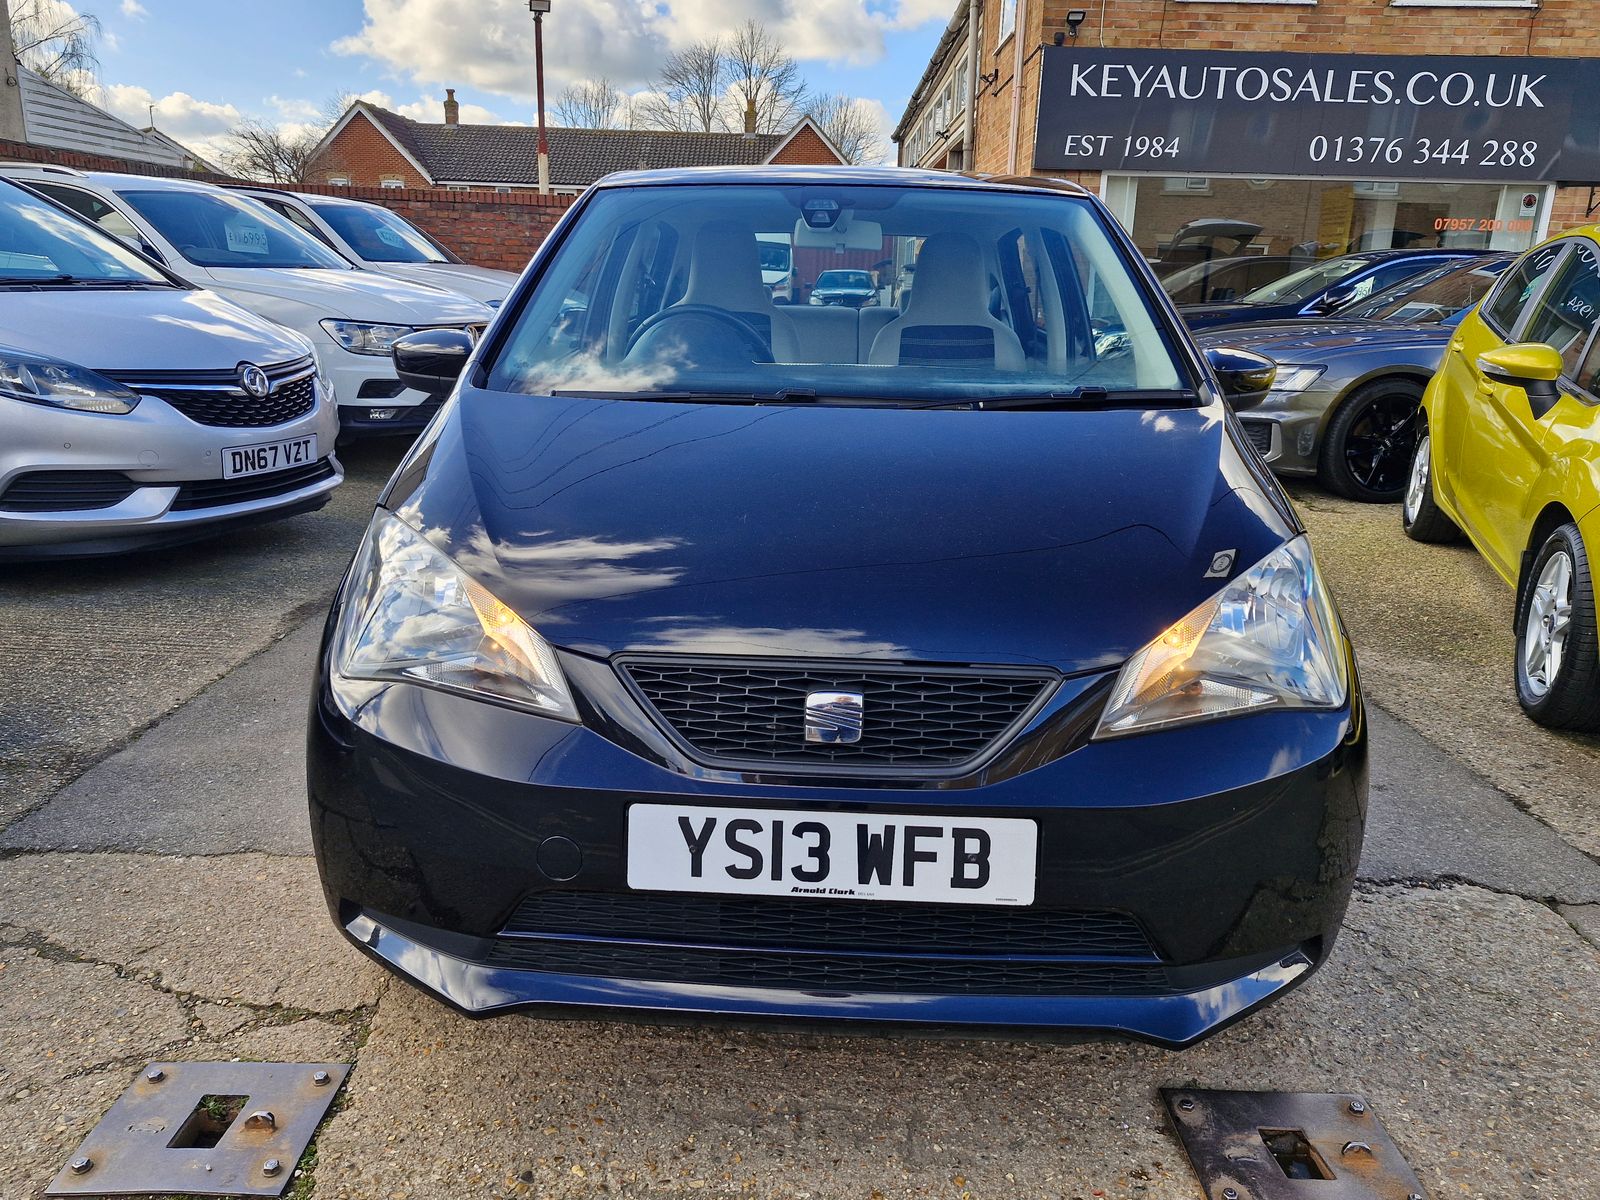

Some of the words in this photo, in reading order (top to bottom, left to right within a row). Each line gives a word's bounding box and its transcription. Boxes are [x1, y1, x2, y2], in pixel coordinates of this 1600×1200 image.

[1070, 63, 1547, 108] KEYAUTOSALES.CO.UK
[1064, 134, 1113, 157] EST
[1123, 135, 1180, 158] 1984
[1308, 135, 1404, 164] 01376
[1412, 137, 1470, 165] 344
[1479, 139, 1538, 168] 288
[1434, 217, 1475, 231] 07957
[231, 446, 279, 474] DN67
[283, 439, 311, 465] VZT
[678, 816, 831, 883] YS13
[857, 823, 992, 890] WFB
[791, 886, 826, 894] Arnold
[828, 888, 856, 896] Clark
